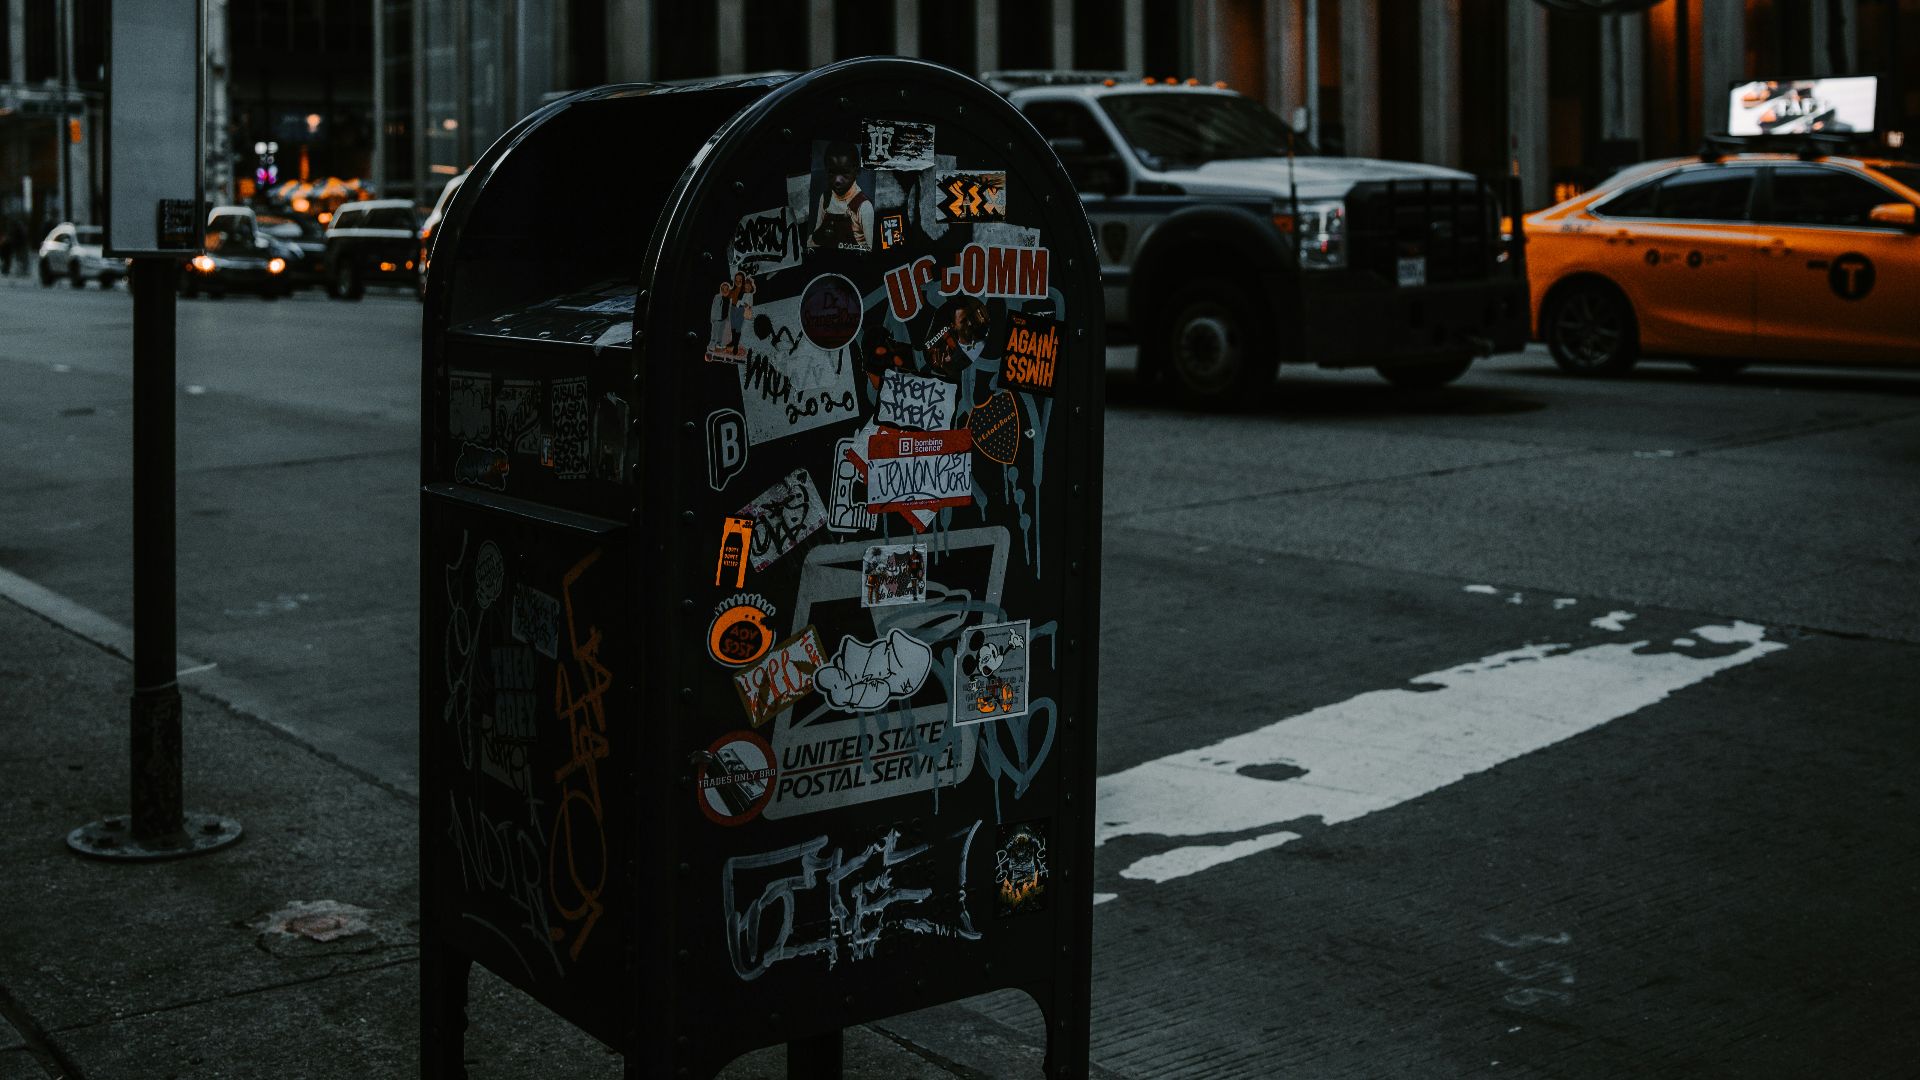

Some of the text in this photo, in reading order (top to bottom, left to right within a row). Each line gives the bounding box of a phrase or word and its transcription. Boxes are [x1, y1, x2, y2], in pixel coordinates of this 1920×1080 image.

[720, 421, 740, 469] B
[914, 439, 943, 447] bombing
[914, 445, 941, 453] science
[782, 733, 873, 770] UNITED
[734, 771, 757, 782] ONLY
[777, 765, 865, 802] POSTAL
